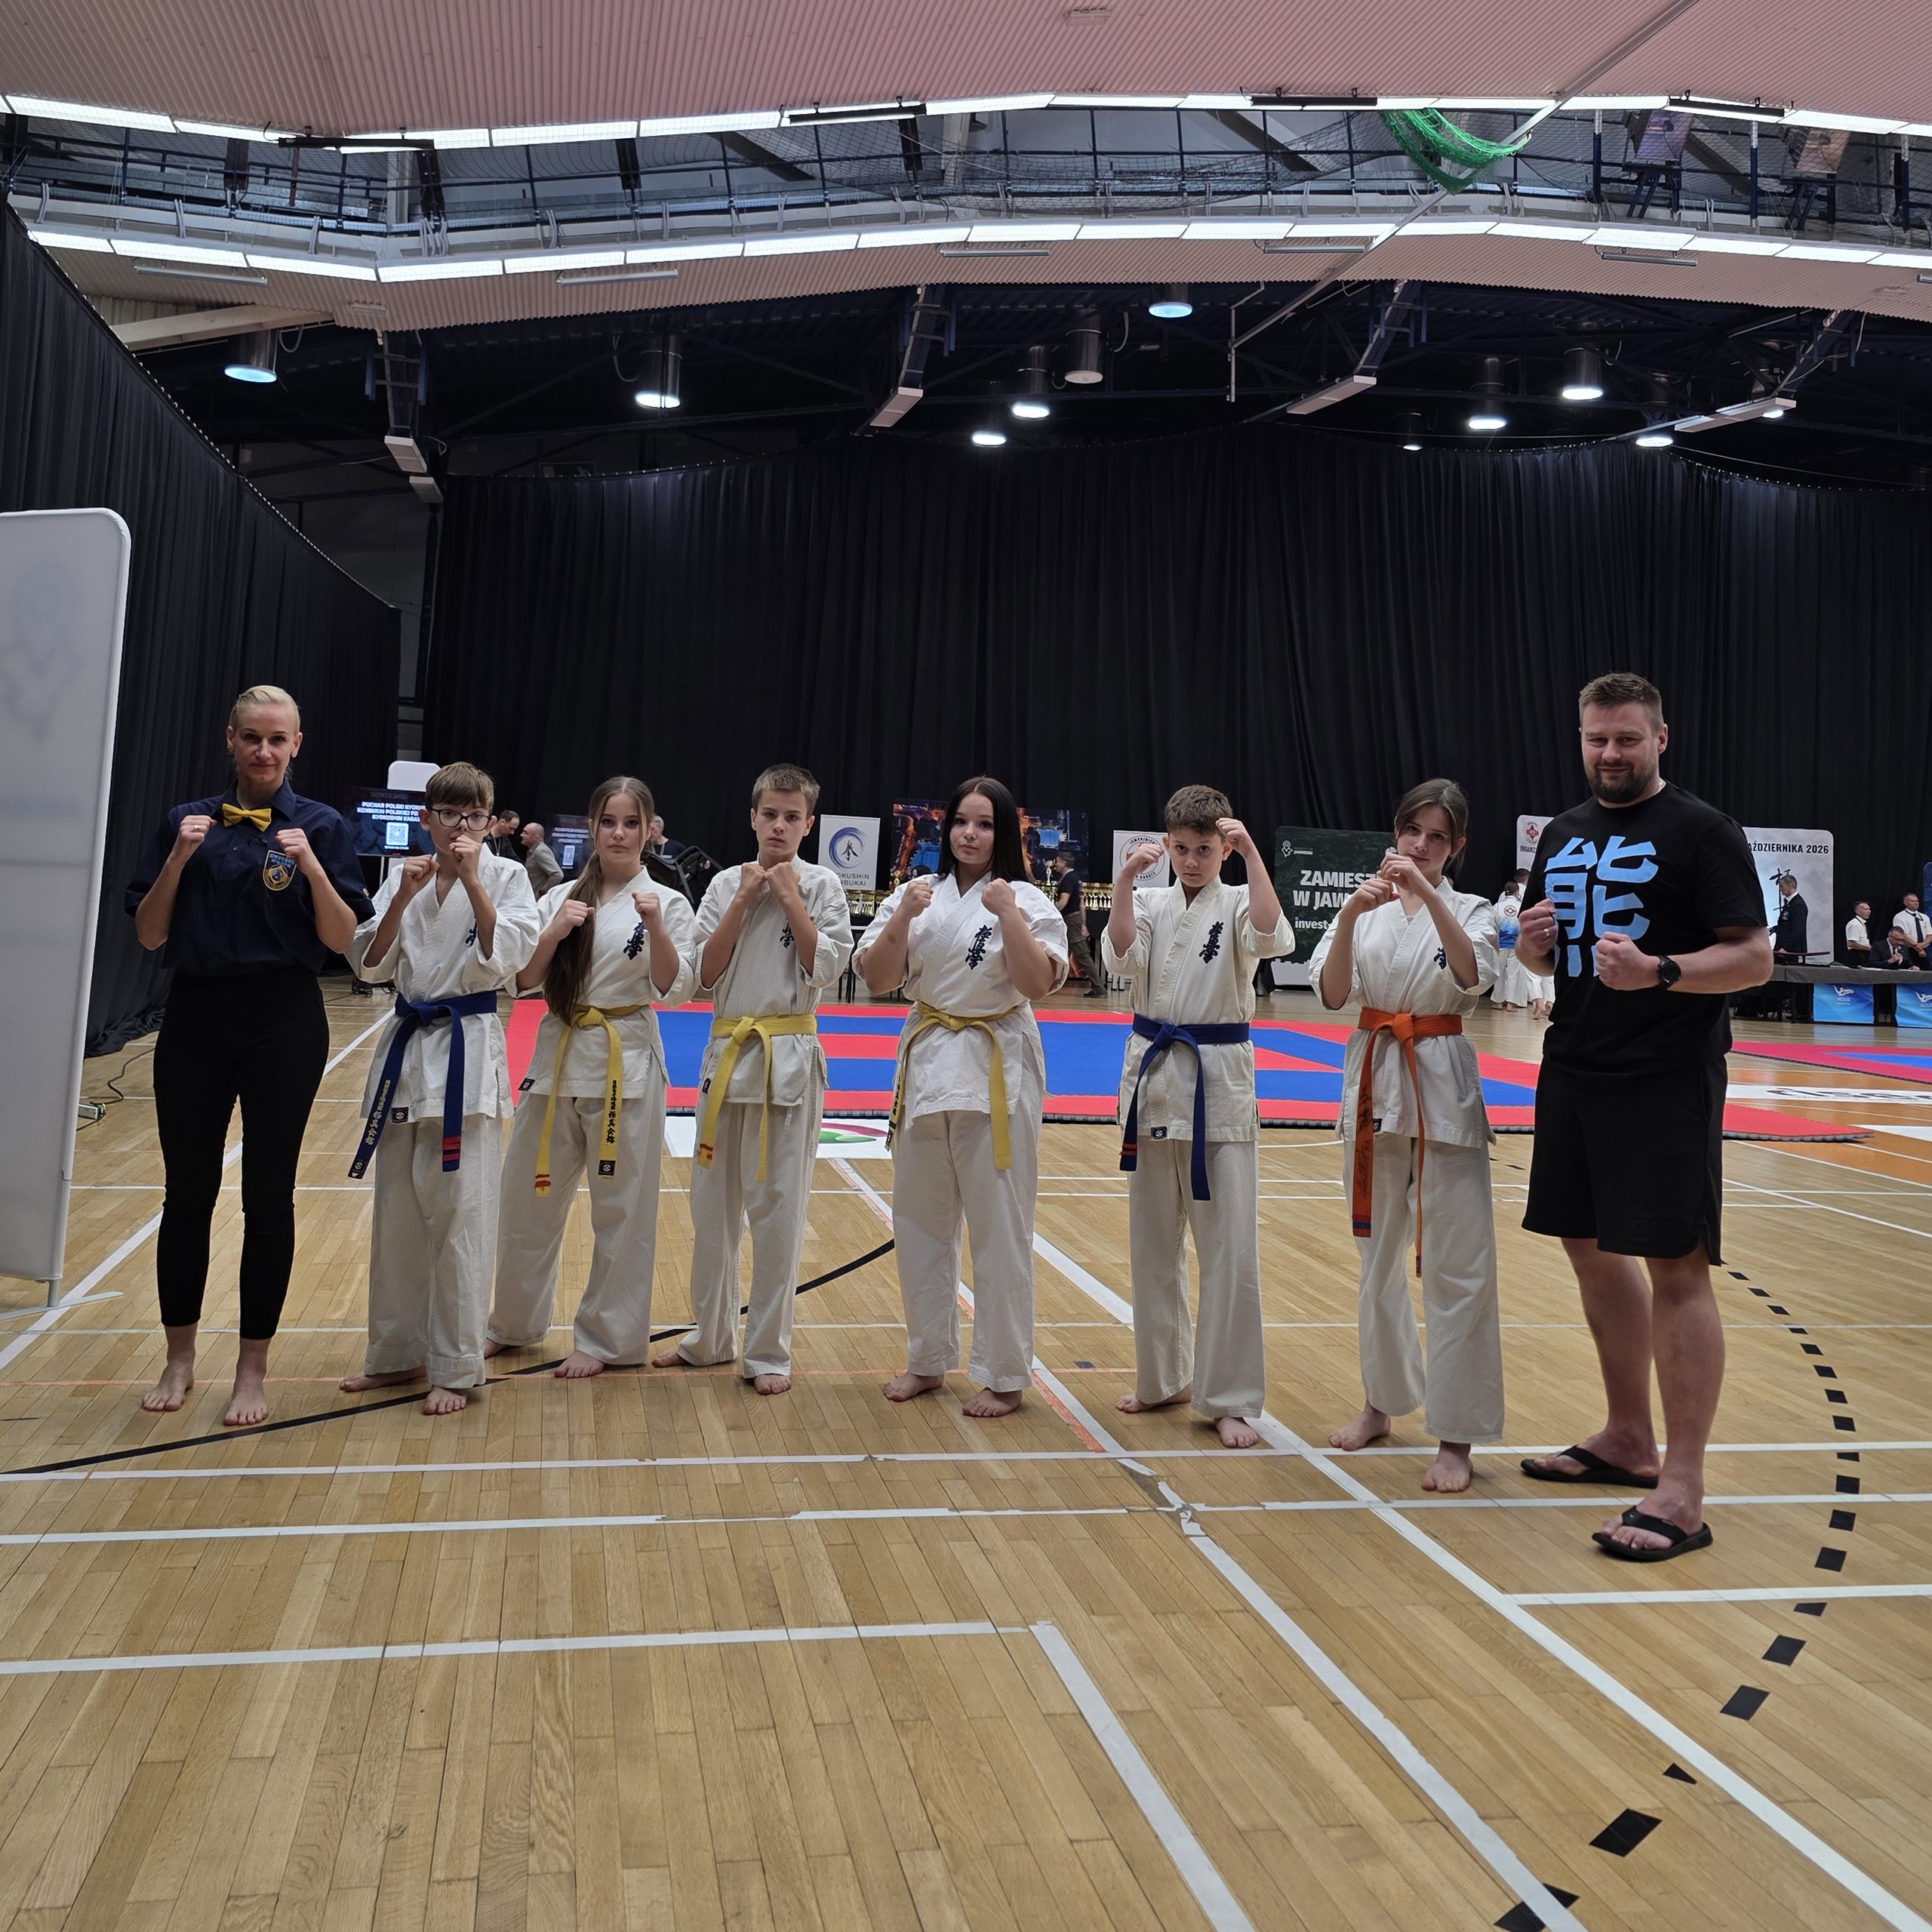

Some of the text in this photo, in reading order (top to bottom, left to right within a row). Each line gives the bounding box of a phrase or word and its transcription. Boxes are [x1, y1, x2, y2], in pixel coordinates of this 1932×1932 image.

[1806, 844, 1829, 854] 2026
[1300, 869, 1383, 889] ZAMIES
[1293, 890, 1311, 906] W
